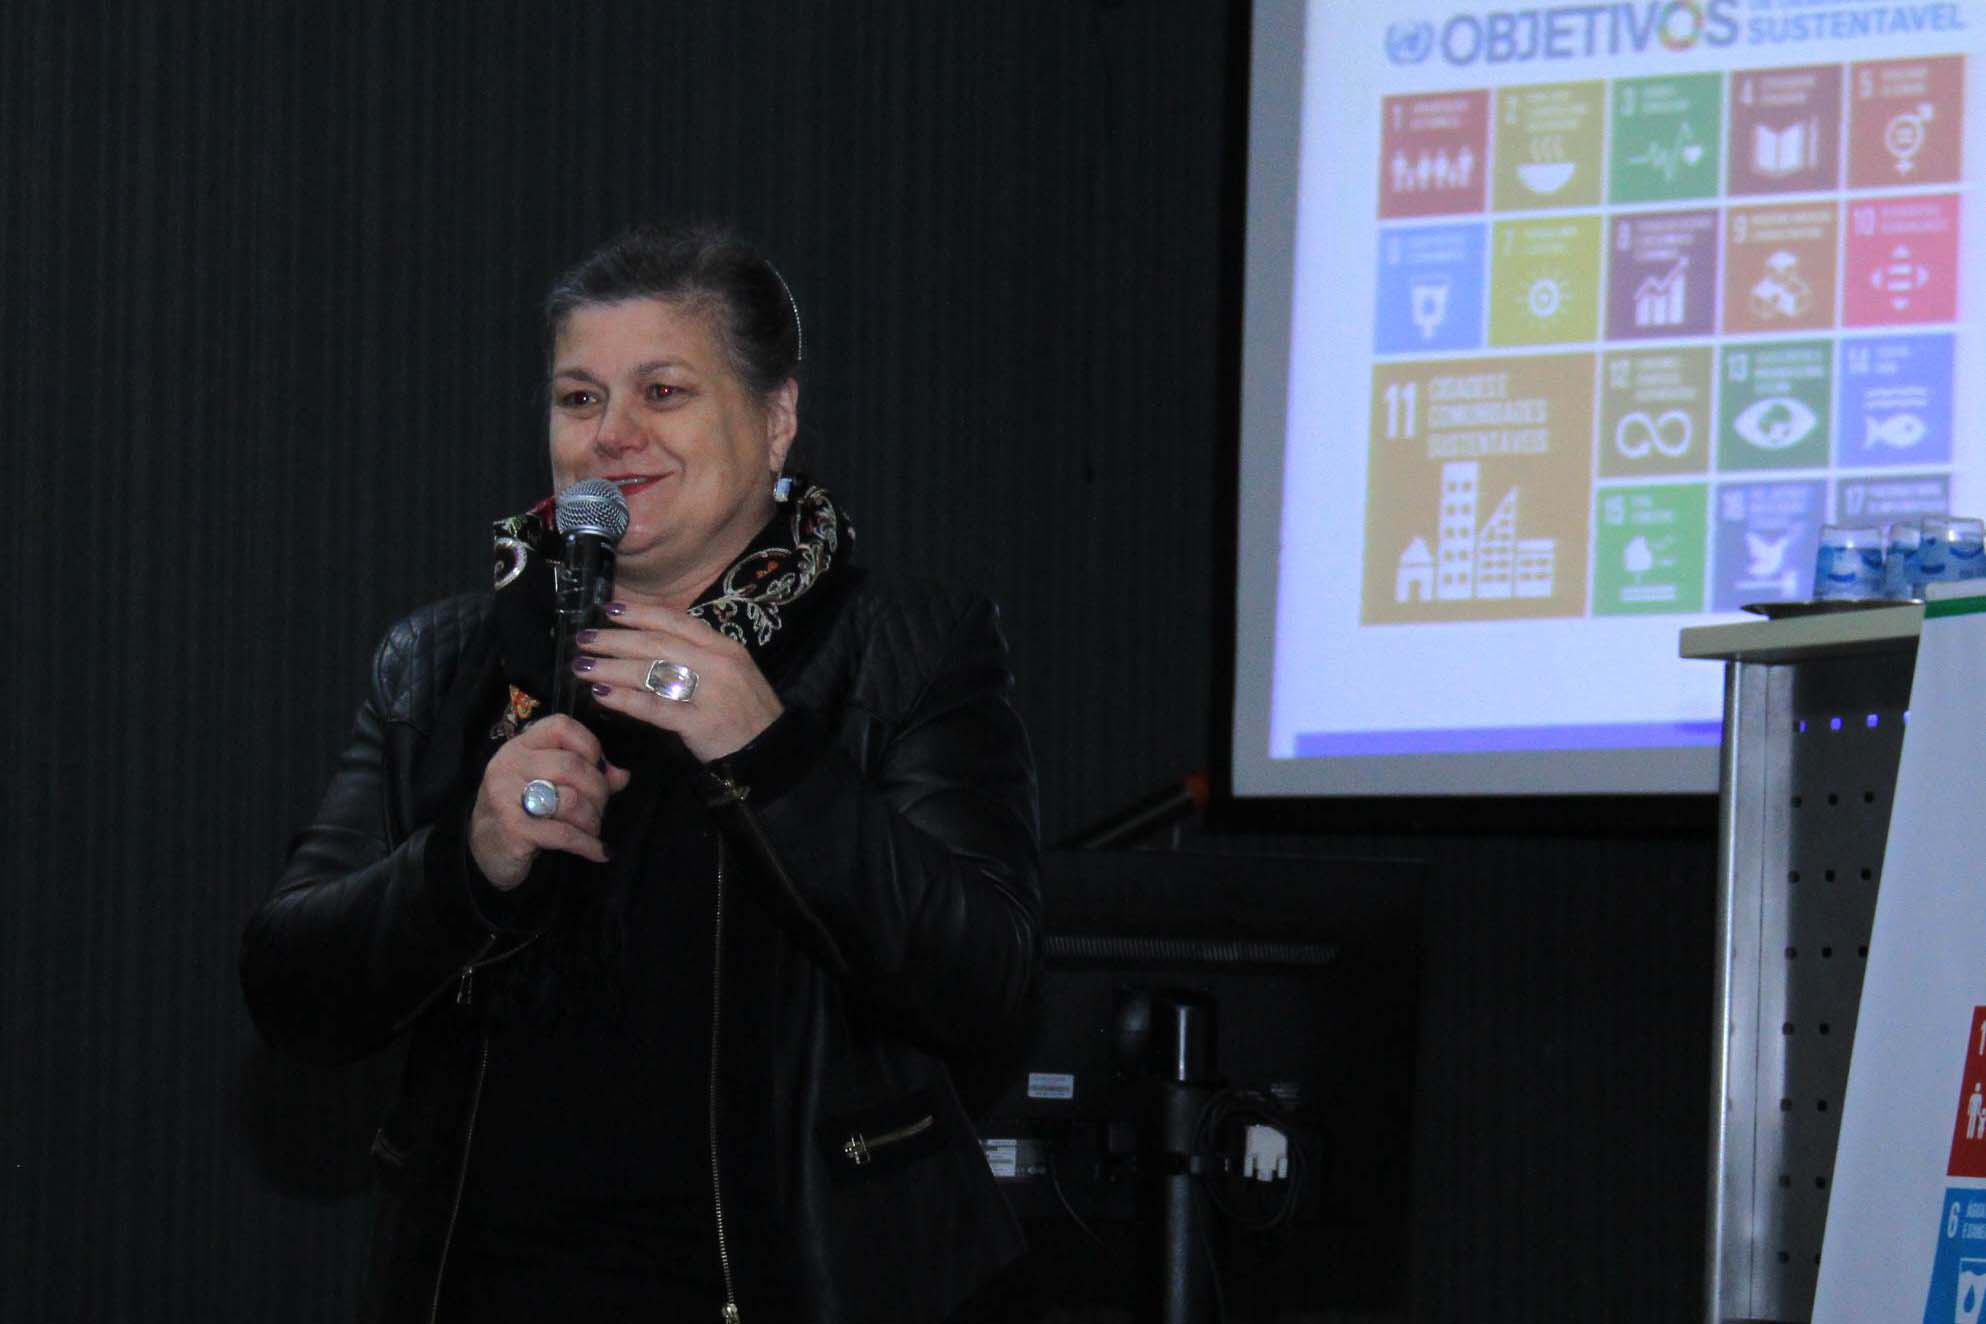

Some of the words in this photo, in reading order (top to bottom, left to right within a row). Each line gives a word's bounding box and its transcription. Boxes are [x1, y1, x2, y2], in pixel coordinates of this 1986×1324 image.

[1441, 0, 1740, 66] OBJETIVOS
[1384, 382, 1417, 439] 11
[1947, 1201, 1961, 1239] 6
